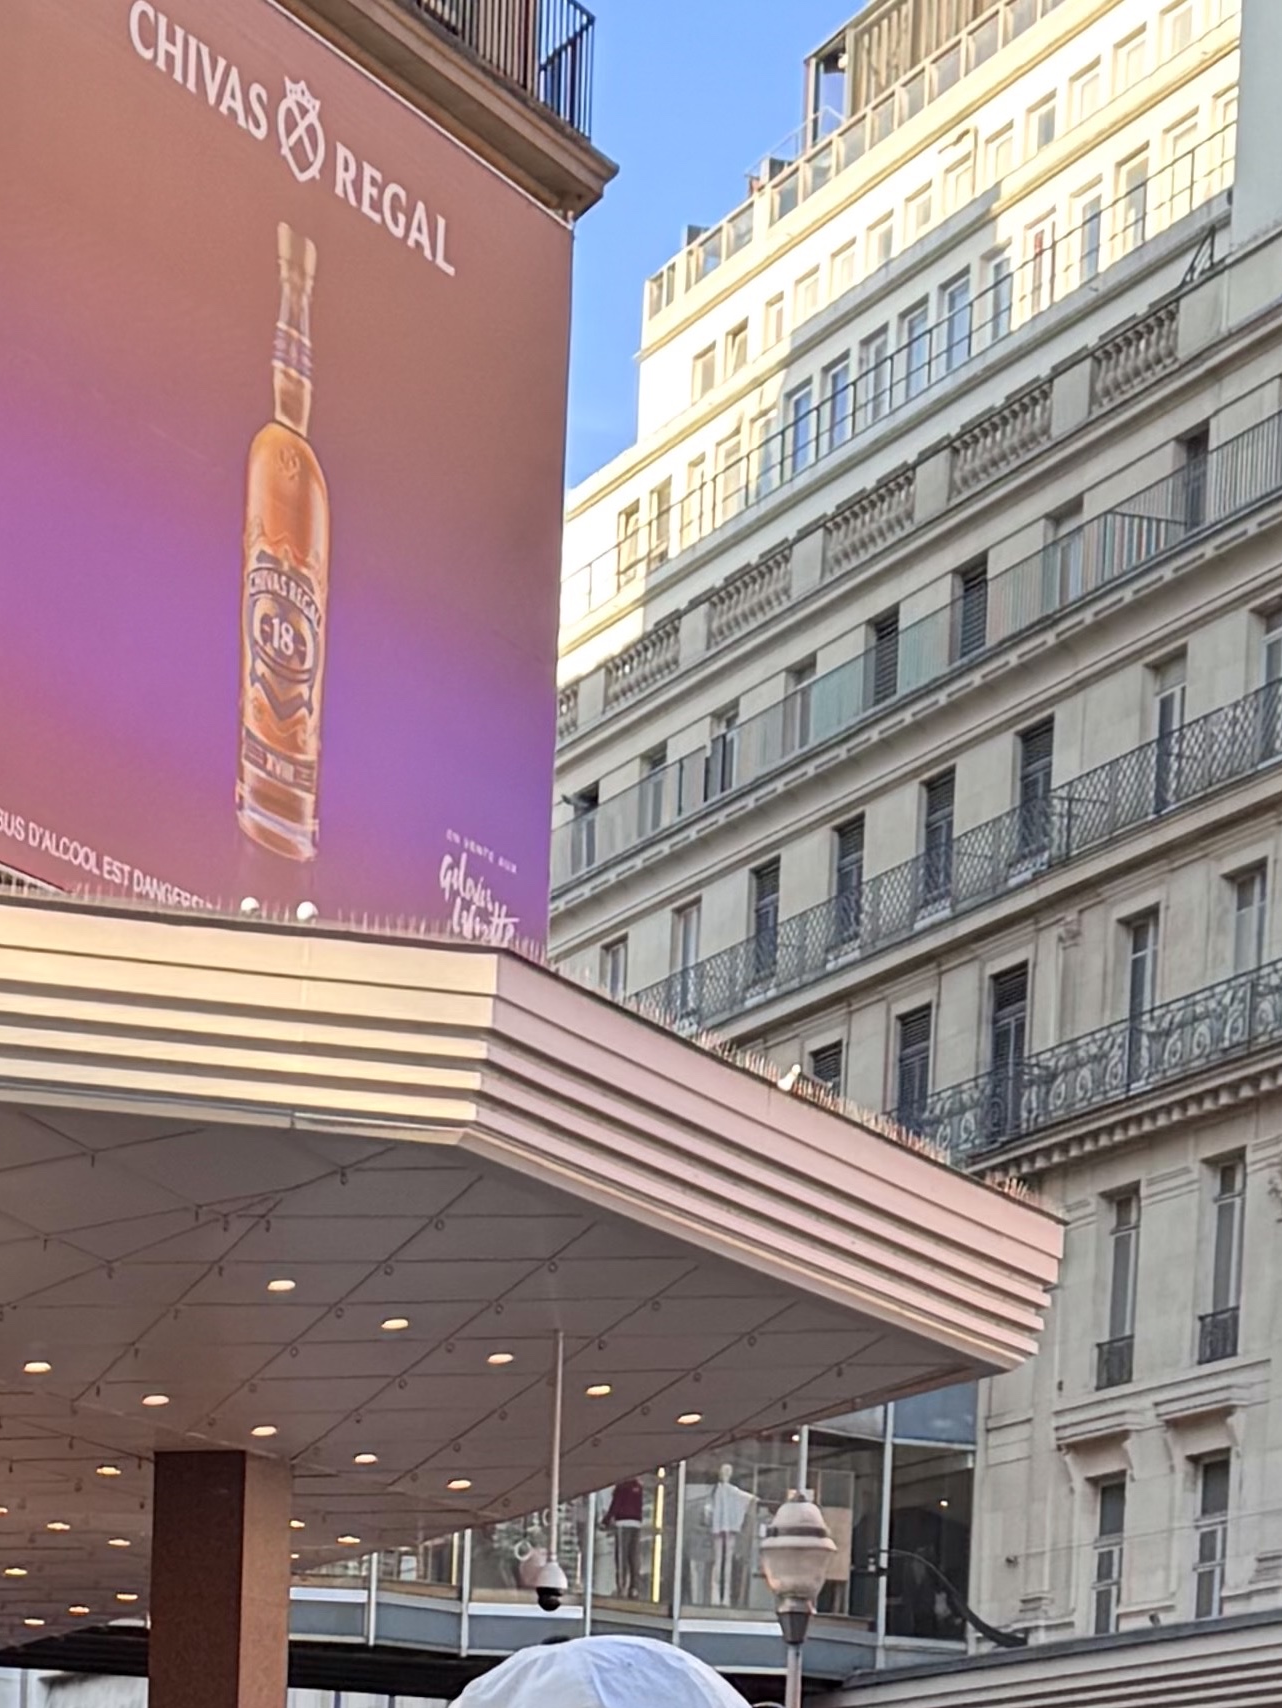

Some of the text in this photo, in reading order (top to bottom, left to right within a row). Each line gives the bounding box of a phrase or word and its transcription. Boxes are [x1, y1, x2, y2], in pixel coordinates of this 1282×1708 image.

[129, 0, 455, 277] CHIVAS REGAL
[271, 617, 295, 656] 18
[28, 821, 100, 876] D'ALCOOL
[103, 855, 131, 887] EST
